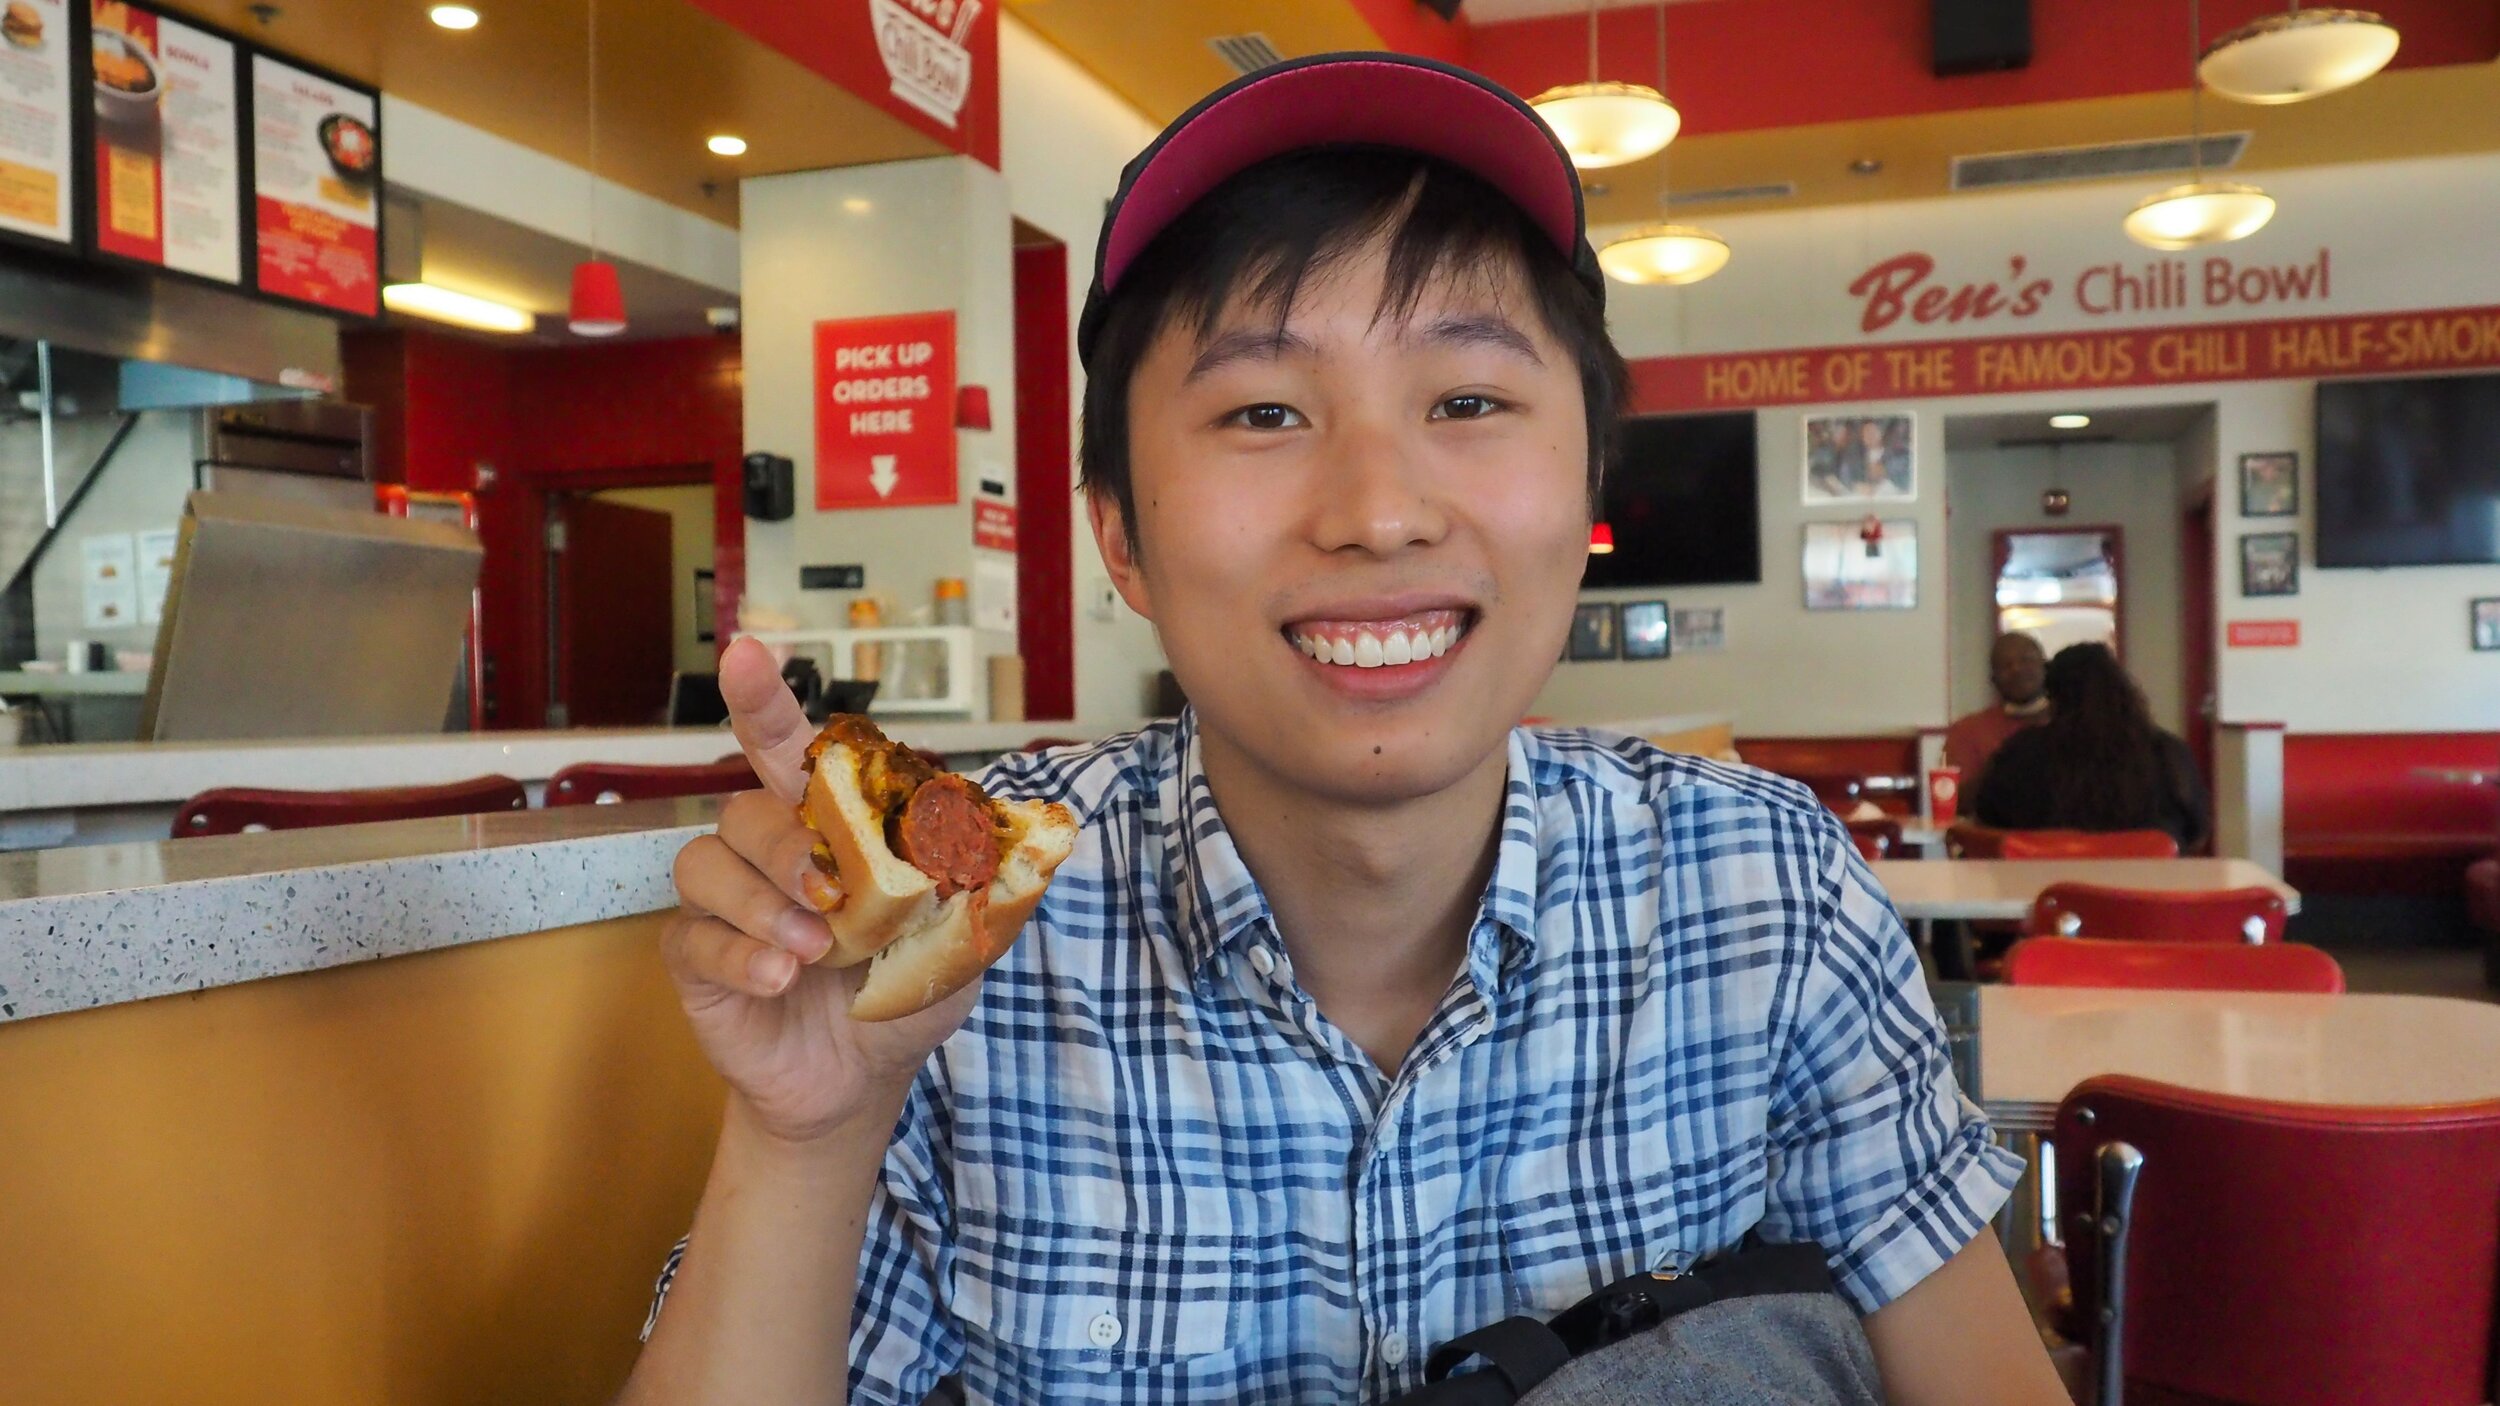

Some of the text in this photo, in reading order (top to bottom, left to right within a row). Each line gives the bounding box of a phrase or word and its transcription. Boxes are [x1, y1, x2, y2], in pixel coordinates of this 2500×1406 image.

[1848, 247, 2331, 334] Ben's Chili Bowl
[836, 342, 933, 370] PICK UP
[1705, 355, 1810, 400] HOME
[1824, 353, 1871, 396] OF
[1886, 348, 1955, 391] THE
[1976, 337, 2135, 387] FAMOUS
[2150, 329, 2246, 376] CHILI
[833, 375, 930, 404] ORDERS
[850, 409, 913, 435] HERE
